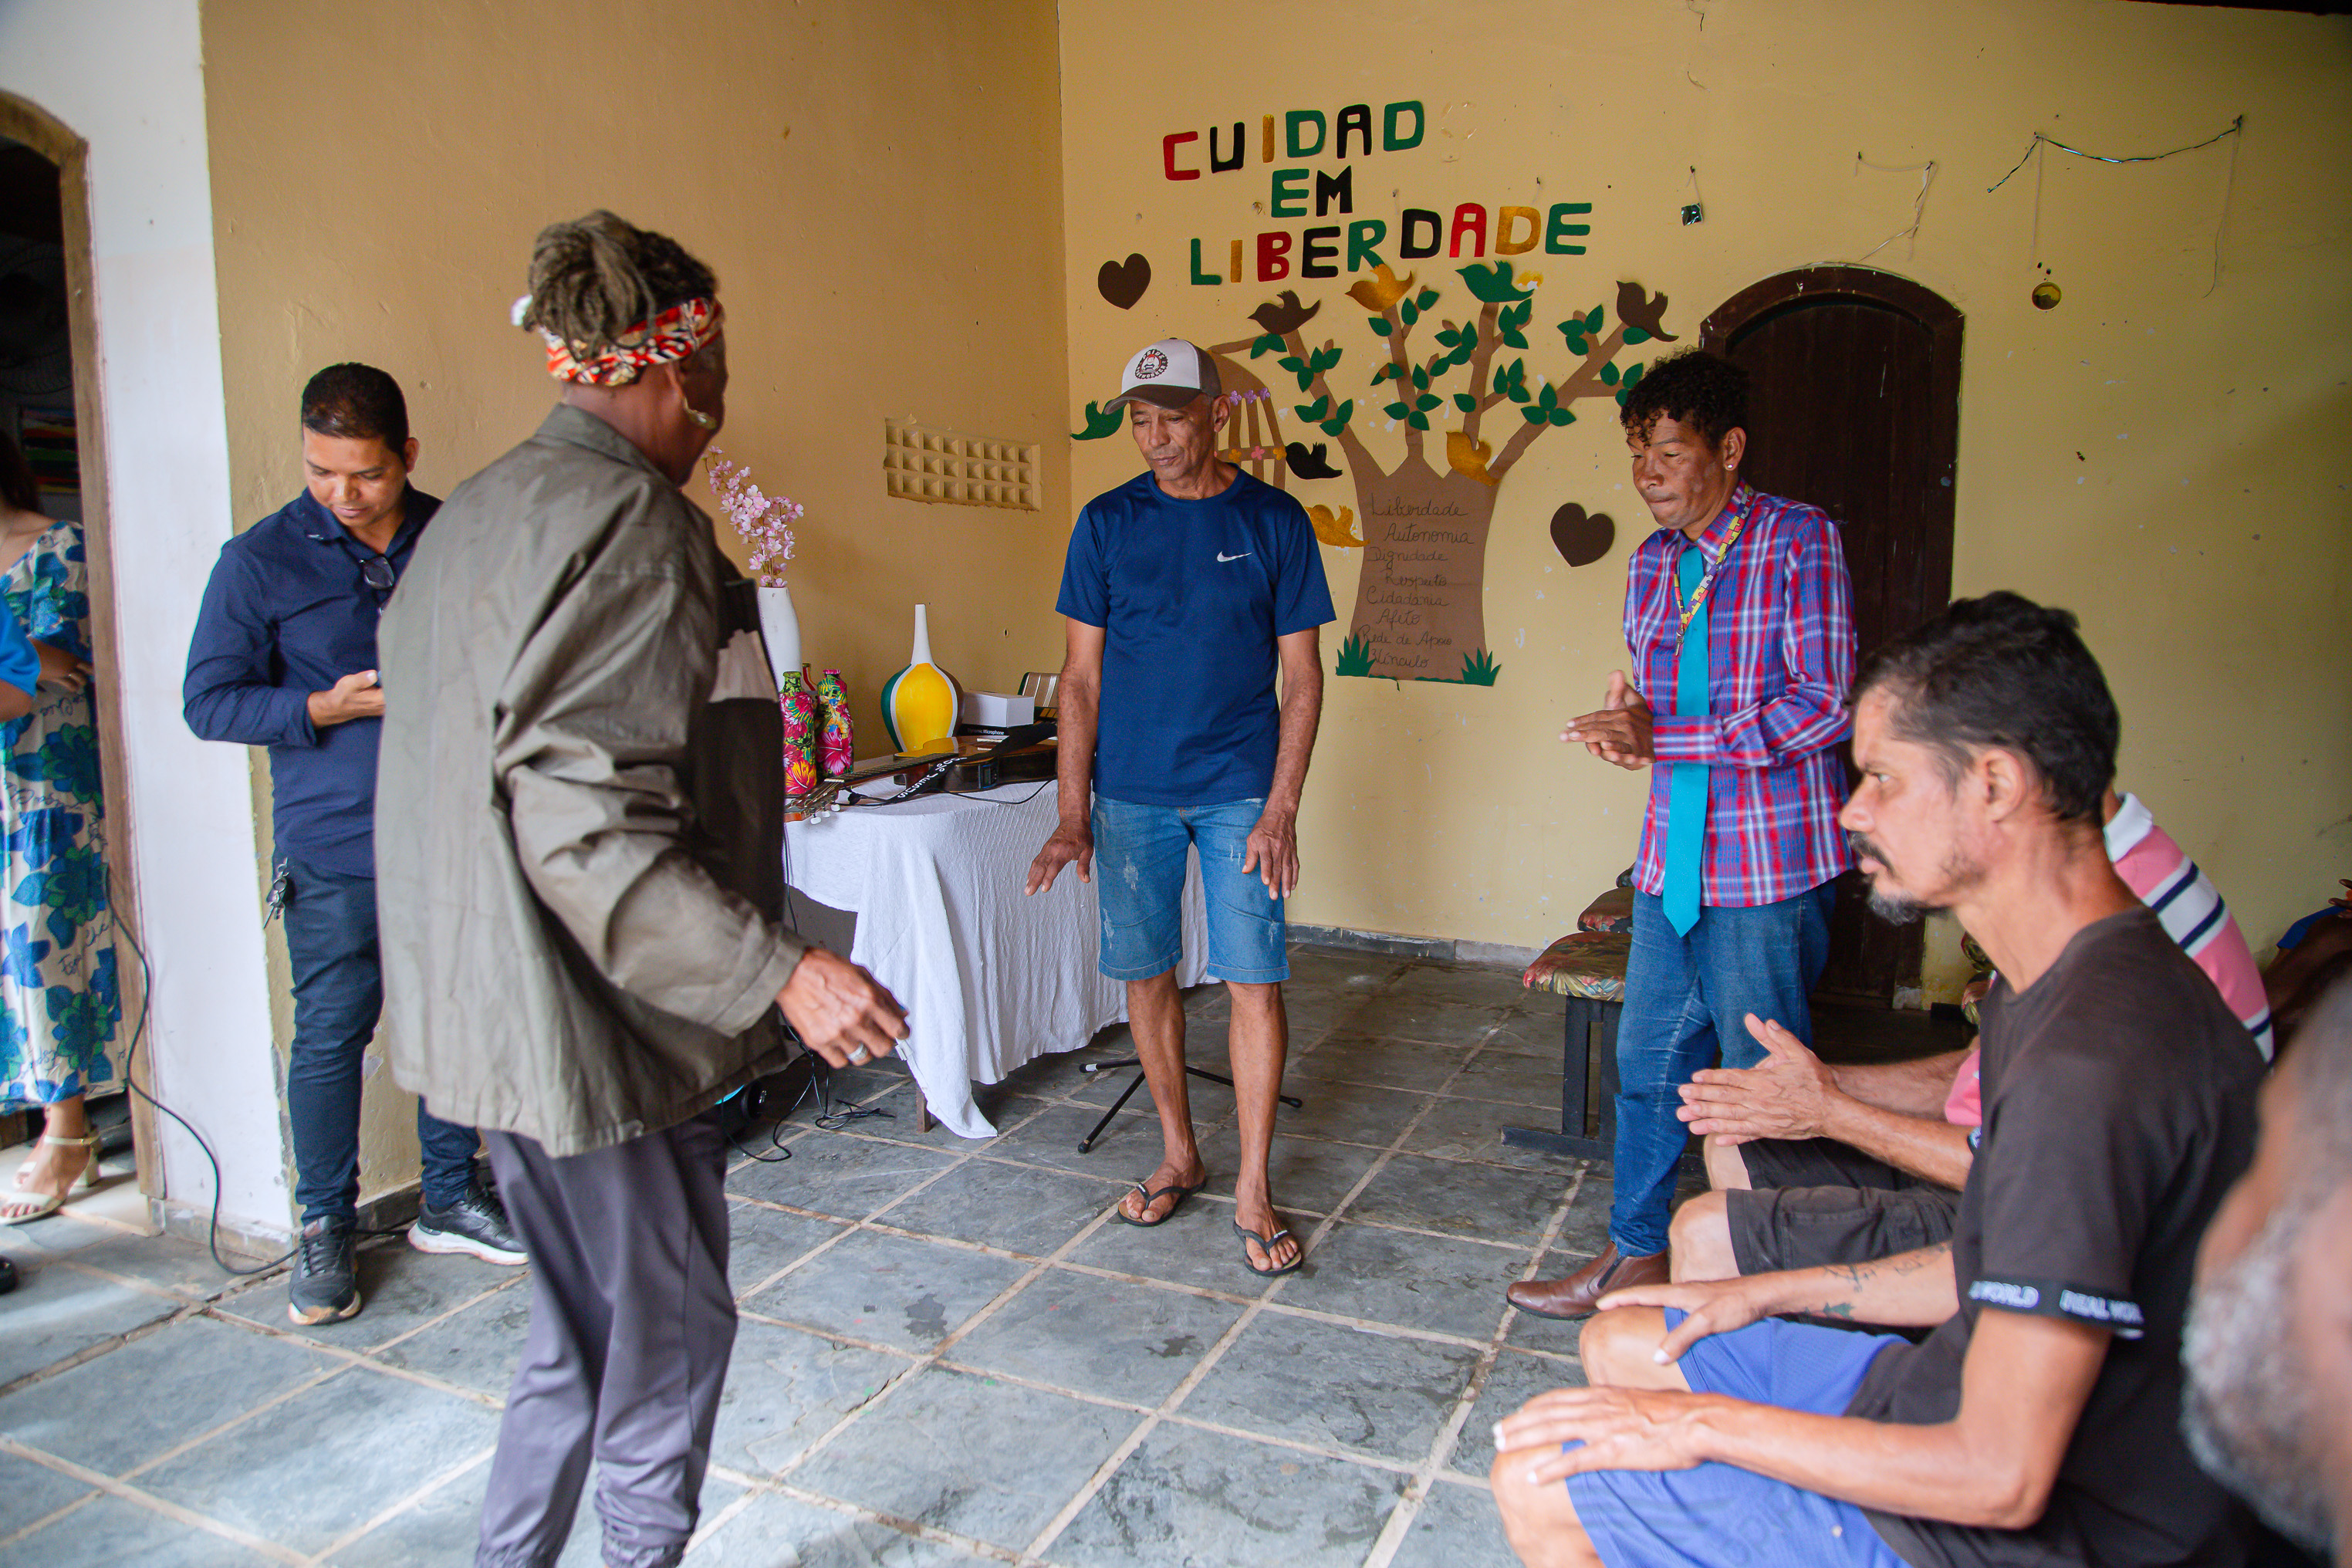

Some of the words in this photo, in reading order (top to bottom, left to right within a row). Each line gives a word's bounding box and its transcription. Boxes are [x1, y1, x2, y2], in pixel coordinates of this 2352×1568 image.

[1162, 100, 1425, 181] CUIDAD
[1270, 165, 1353, 218] EM
[1190, 202, 1593, 286] LIBERDADE
[1370, 492, 1468, 516] Liberdade
[1384, 522, 1475, 545] Autonomia
[1367, 546, 1448, 569] Dignidade
[1380, 568, 1448, 590] Respeito
[1366, 585, 1450, 607] Cidadania
[1376, 607, 1422, 630] Afeto
[1358, 624, 1391, 645] Rede
[1396, 634, 1411, 645] de
[1416, 631, 1453, 651] Apoio
[897, 772, 939, 799] JESUS
